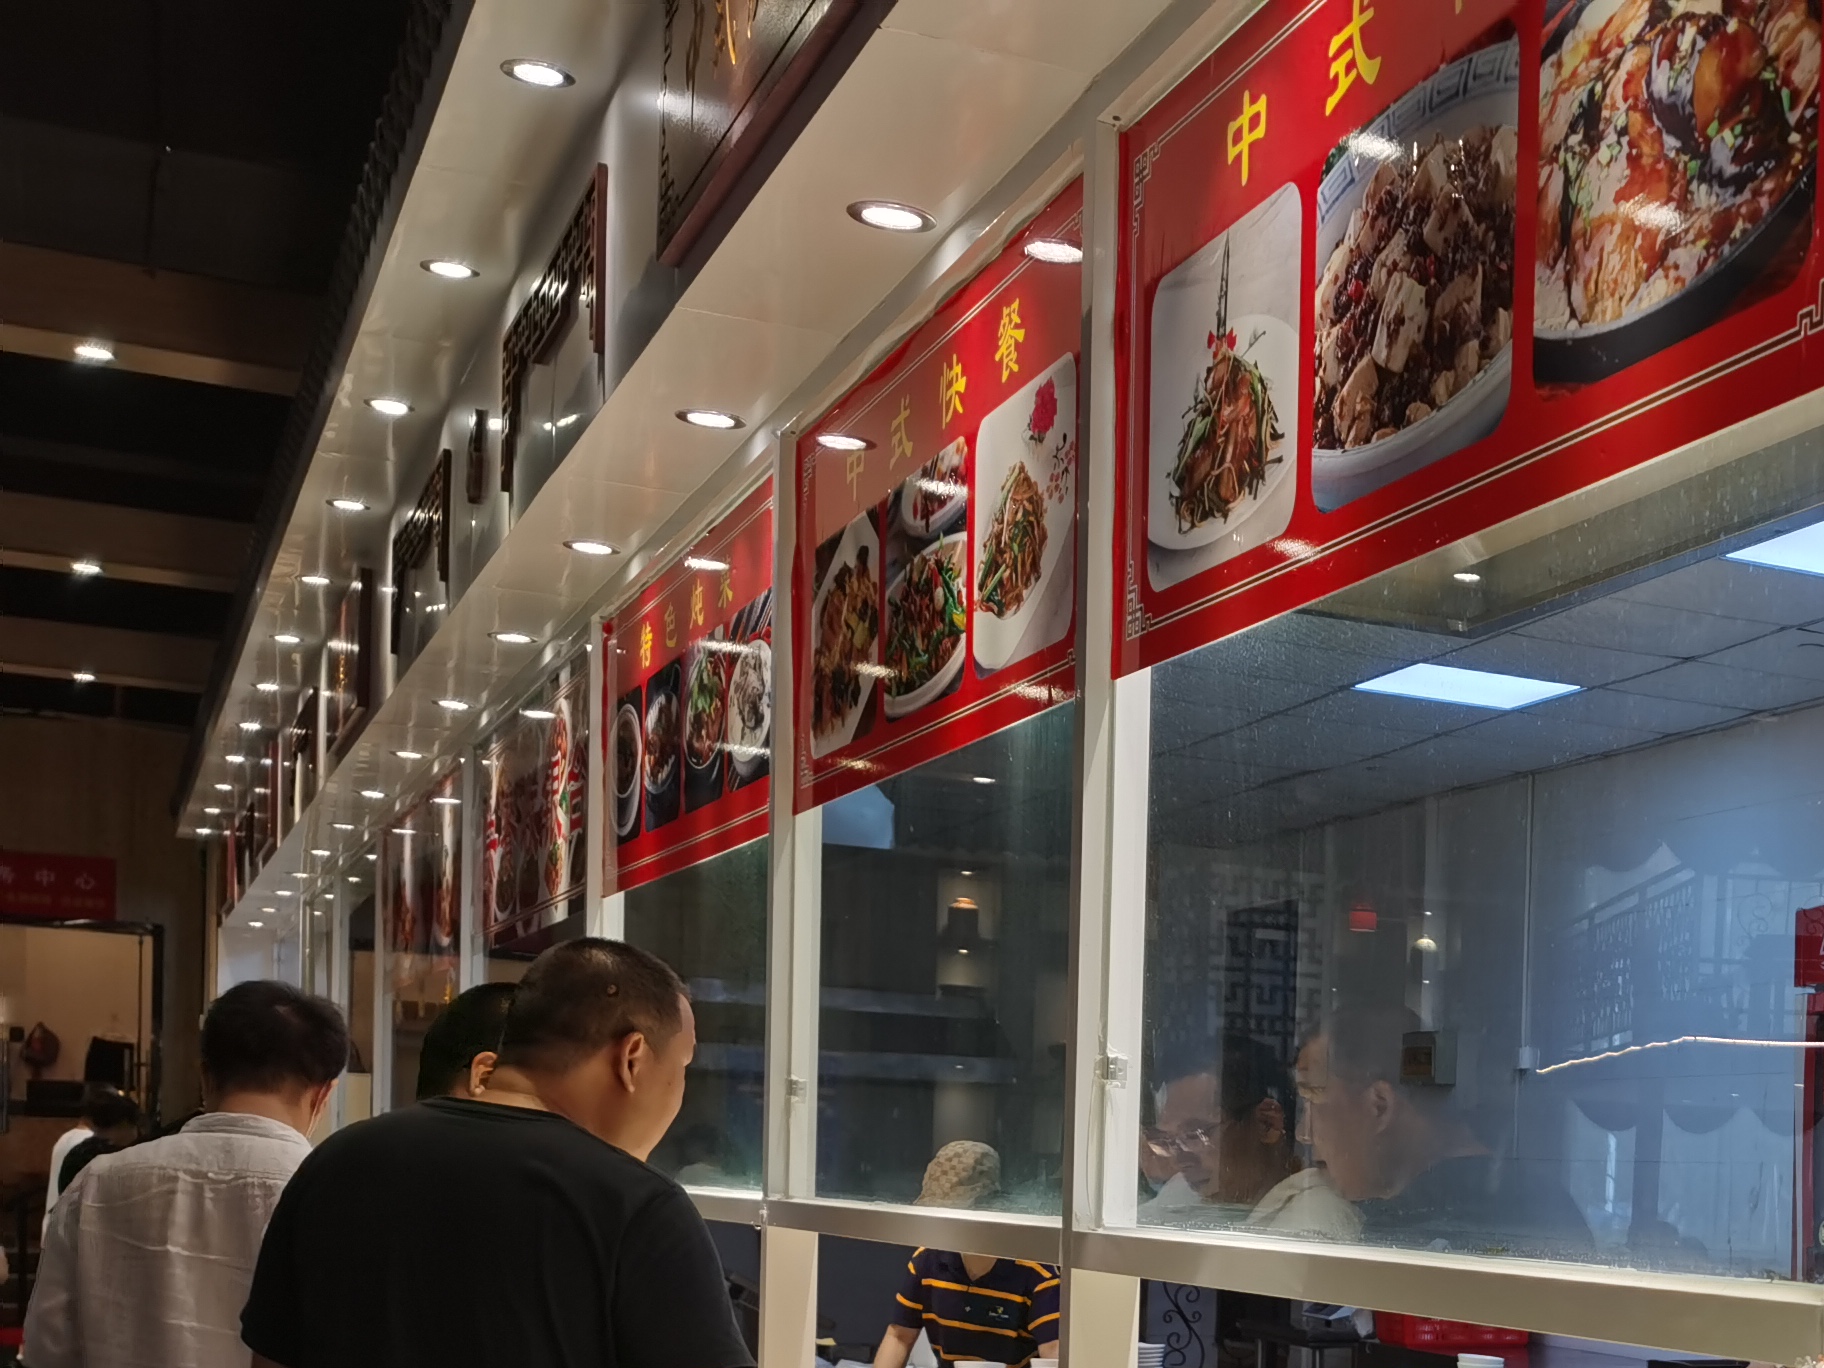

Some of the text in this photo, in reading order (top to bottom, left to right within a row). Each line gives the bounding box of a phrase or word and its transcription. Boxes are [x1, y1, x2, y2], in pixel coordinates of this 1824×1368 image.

[1227, 0, 1462, 187] 中式
[847, 298, 1025, 501] 中式快餐
[640, 553, 733, 669] 特色炖菜
